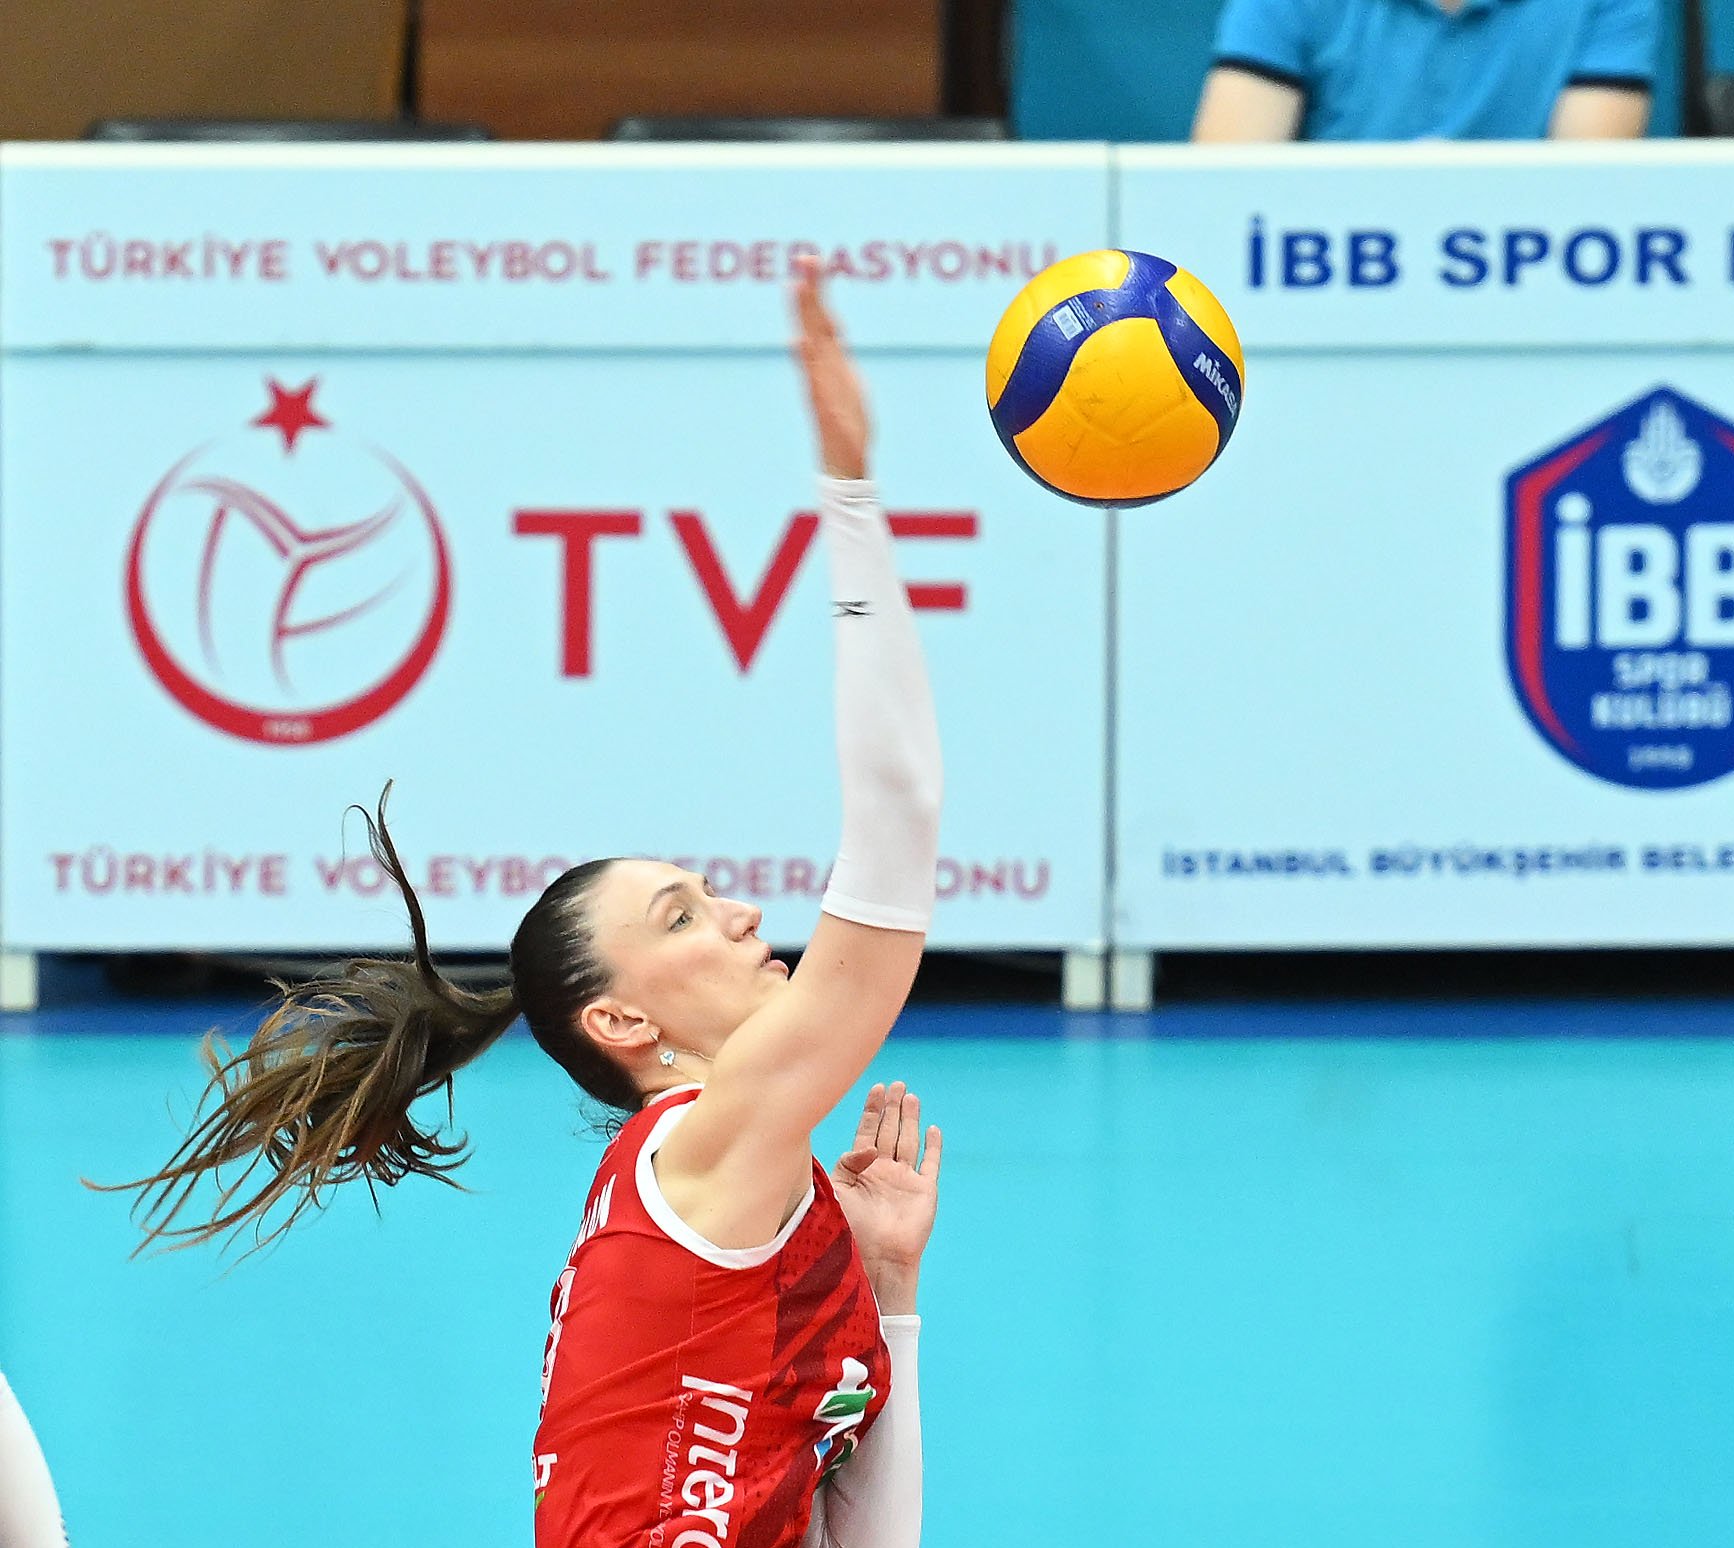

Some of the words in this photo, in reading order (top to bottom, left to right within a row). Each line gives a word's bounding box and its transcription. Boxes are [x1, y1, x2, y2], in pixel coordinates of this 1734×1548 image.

[47, 232, 288, 282] TÜRKİYE
[315, 239, 610, 283] VOLEYBOL
[634, 239, 1057, 284] FEDERASYONU
[1246, 213, 1400, 290] İBB
[1437, 226, 1690, 289] SPOR
[48, 847, 288, 897] TÜRKİYE
[315, 855, 573, 897] VOEYBO
